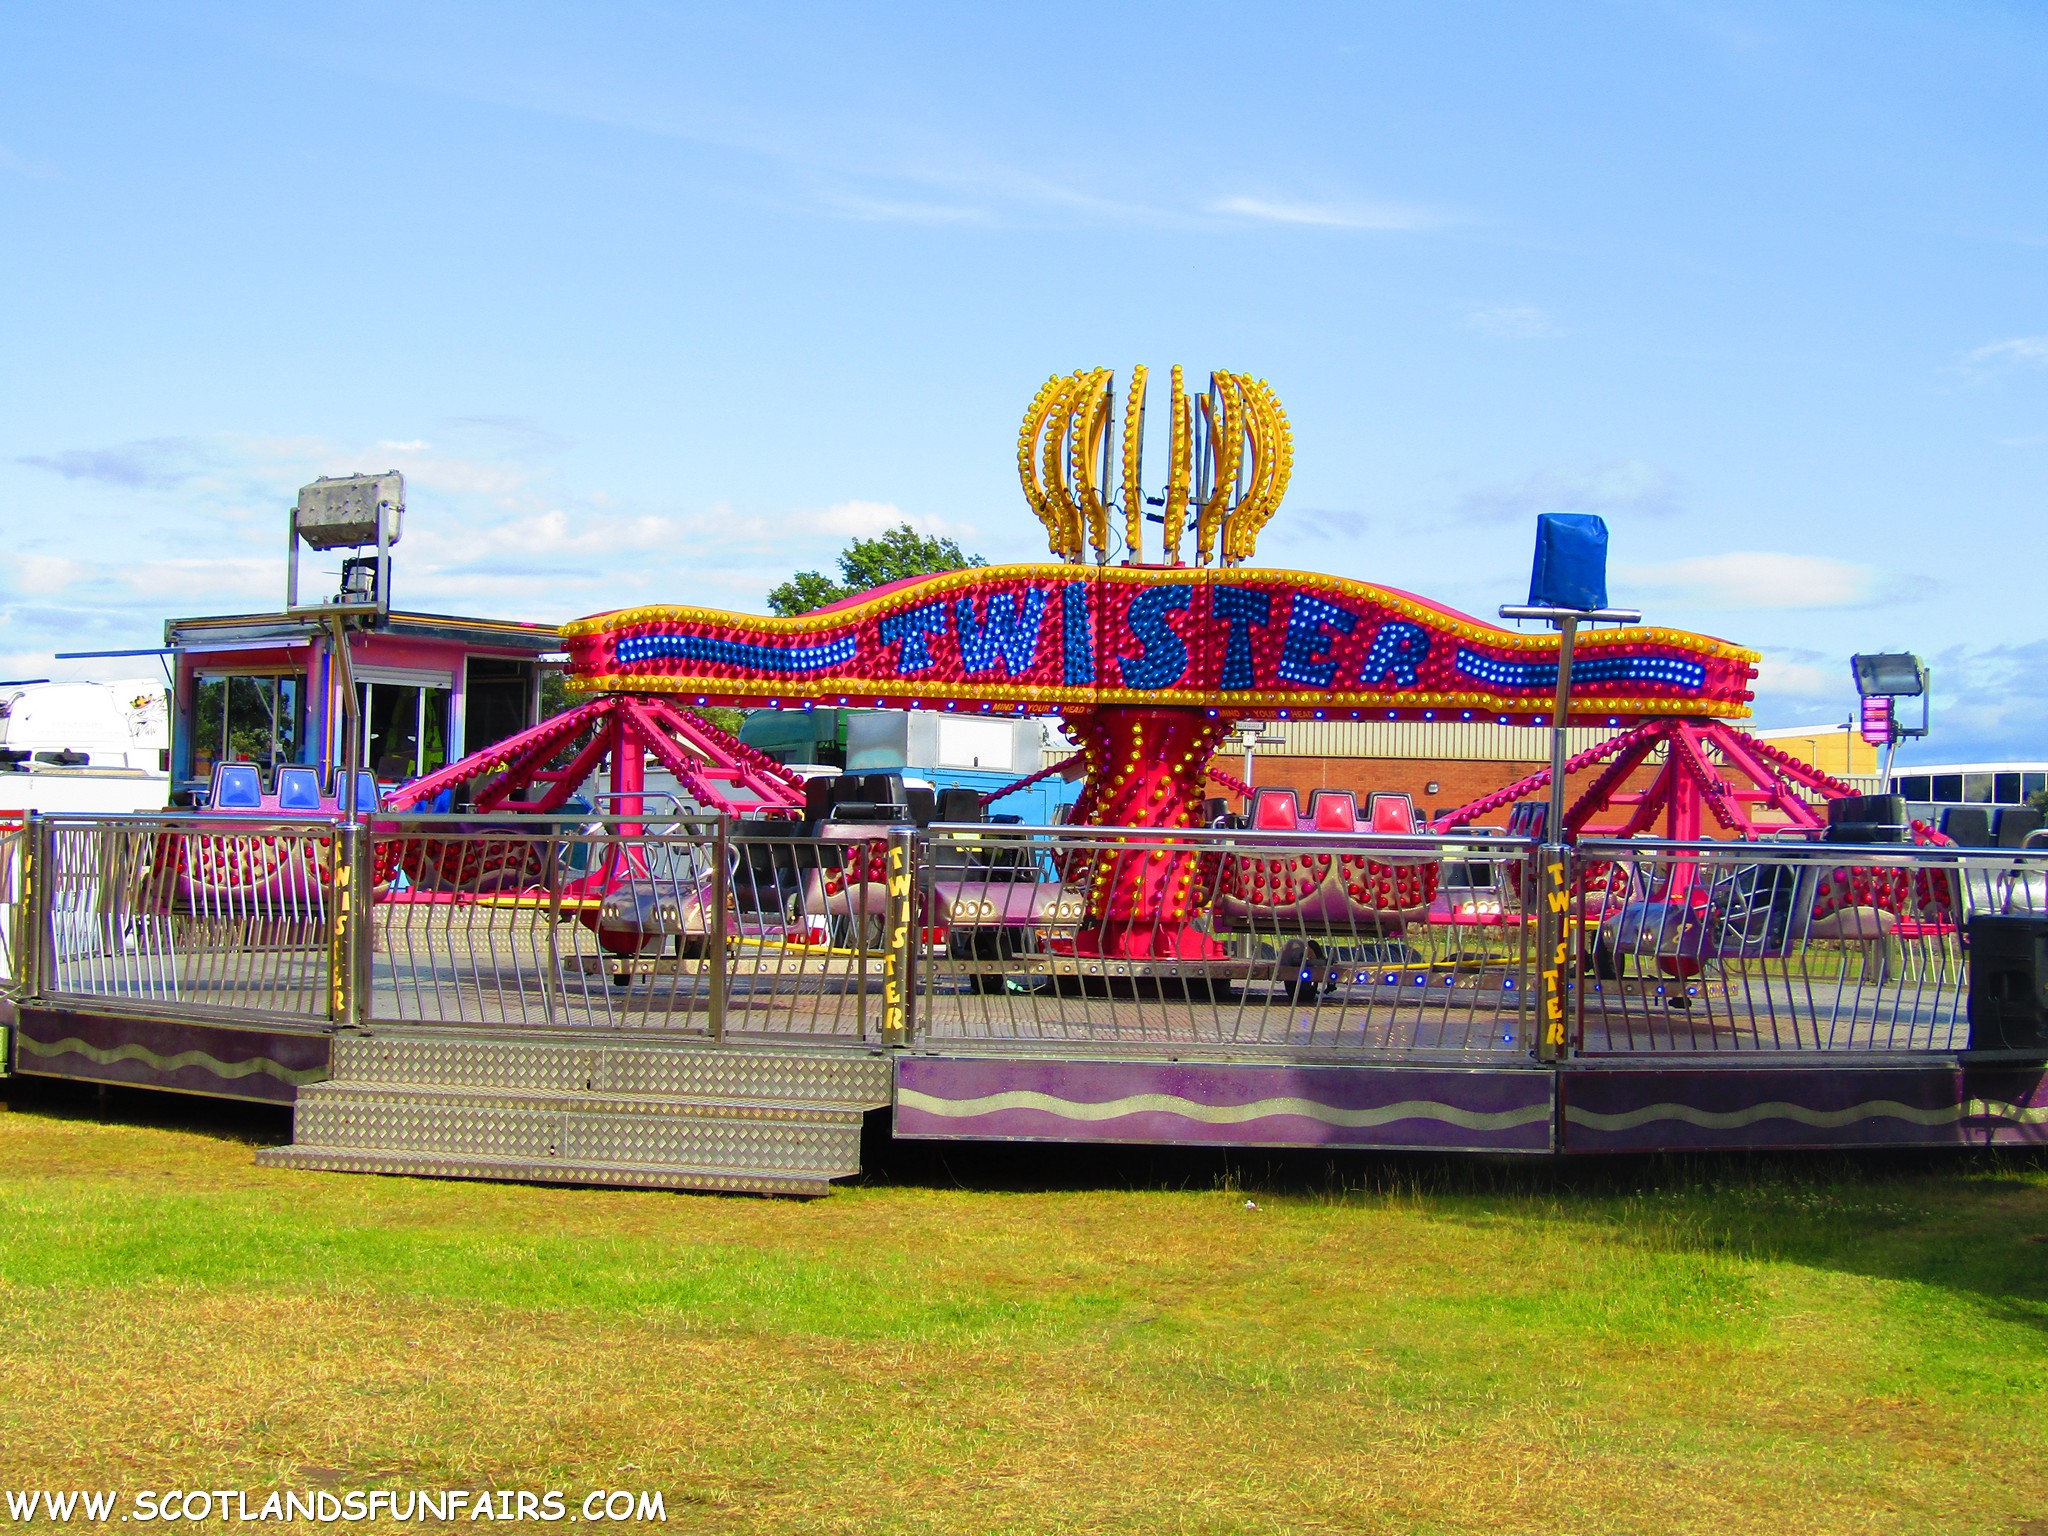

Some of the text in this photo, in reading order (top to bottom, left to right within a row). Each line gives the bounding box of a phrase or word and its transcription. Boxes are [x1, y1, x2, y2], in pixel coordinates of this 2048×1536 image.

[879, 580, 1431, 690] TWISTER
[992, 703, 1085, 714] MIND YOUR HEAD
[1218, 709, 1314, 718] MIND YOUR HEAD
[885, 846, 912, 1030] TWISTER
[1543, 863, 1570, 1045] TWISTER
